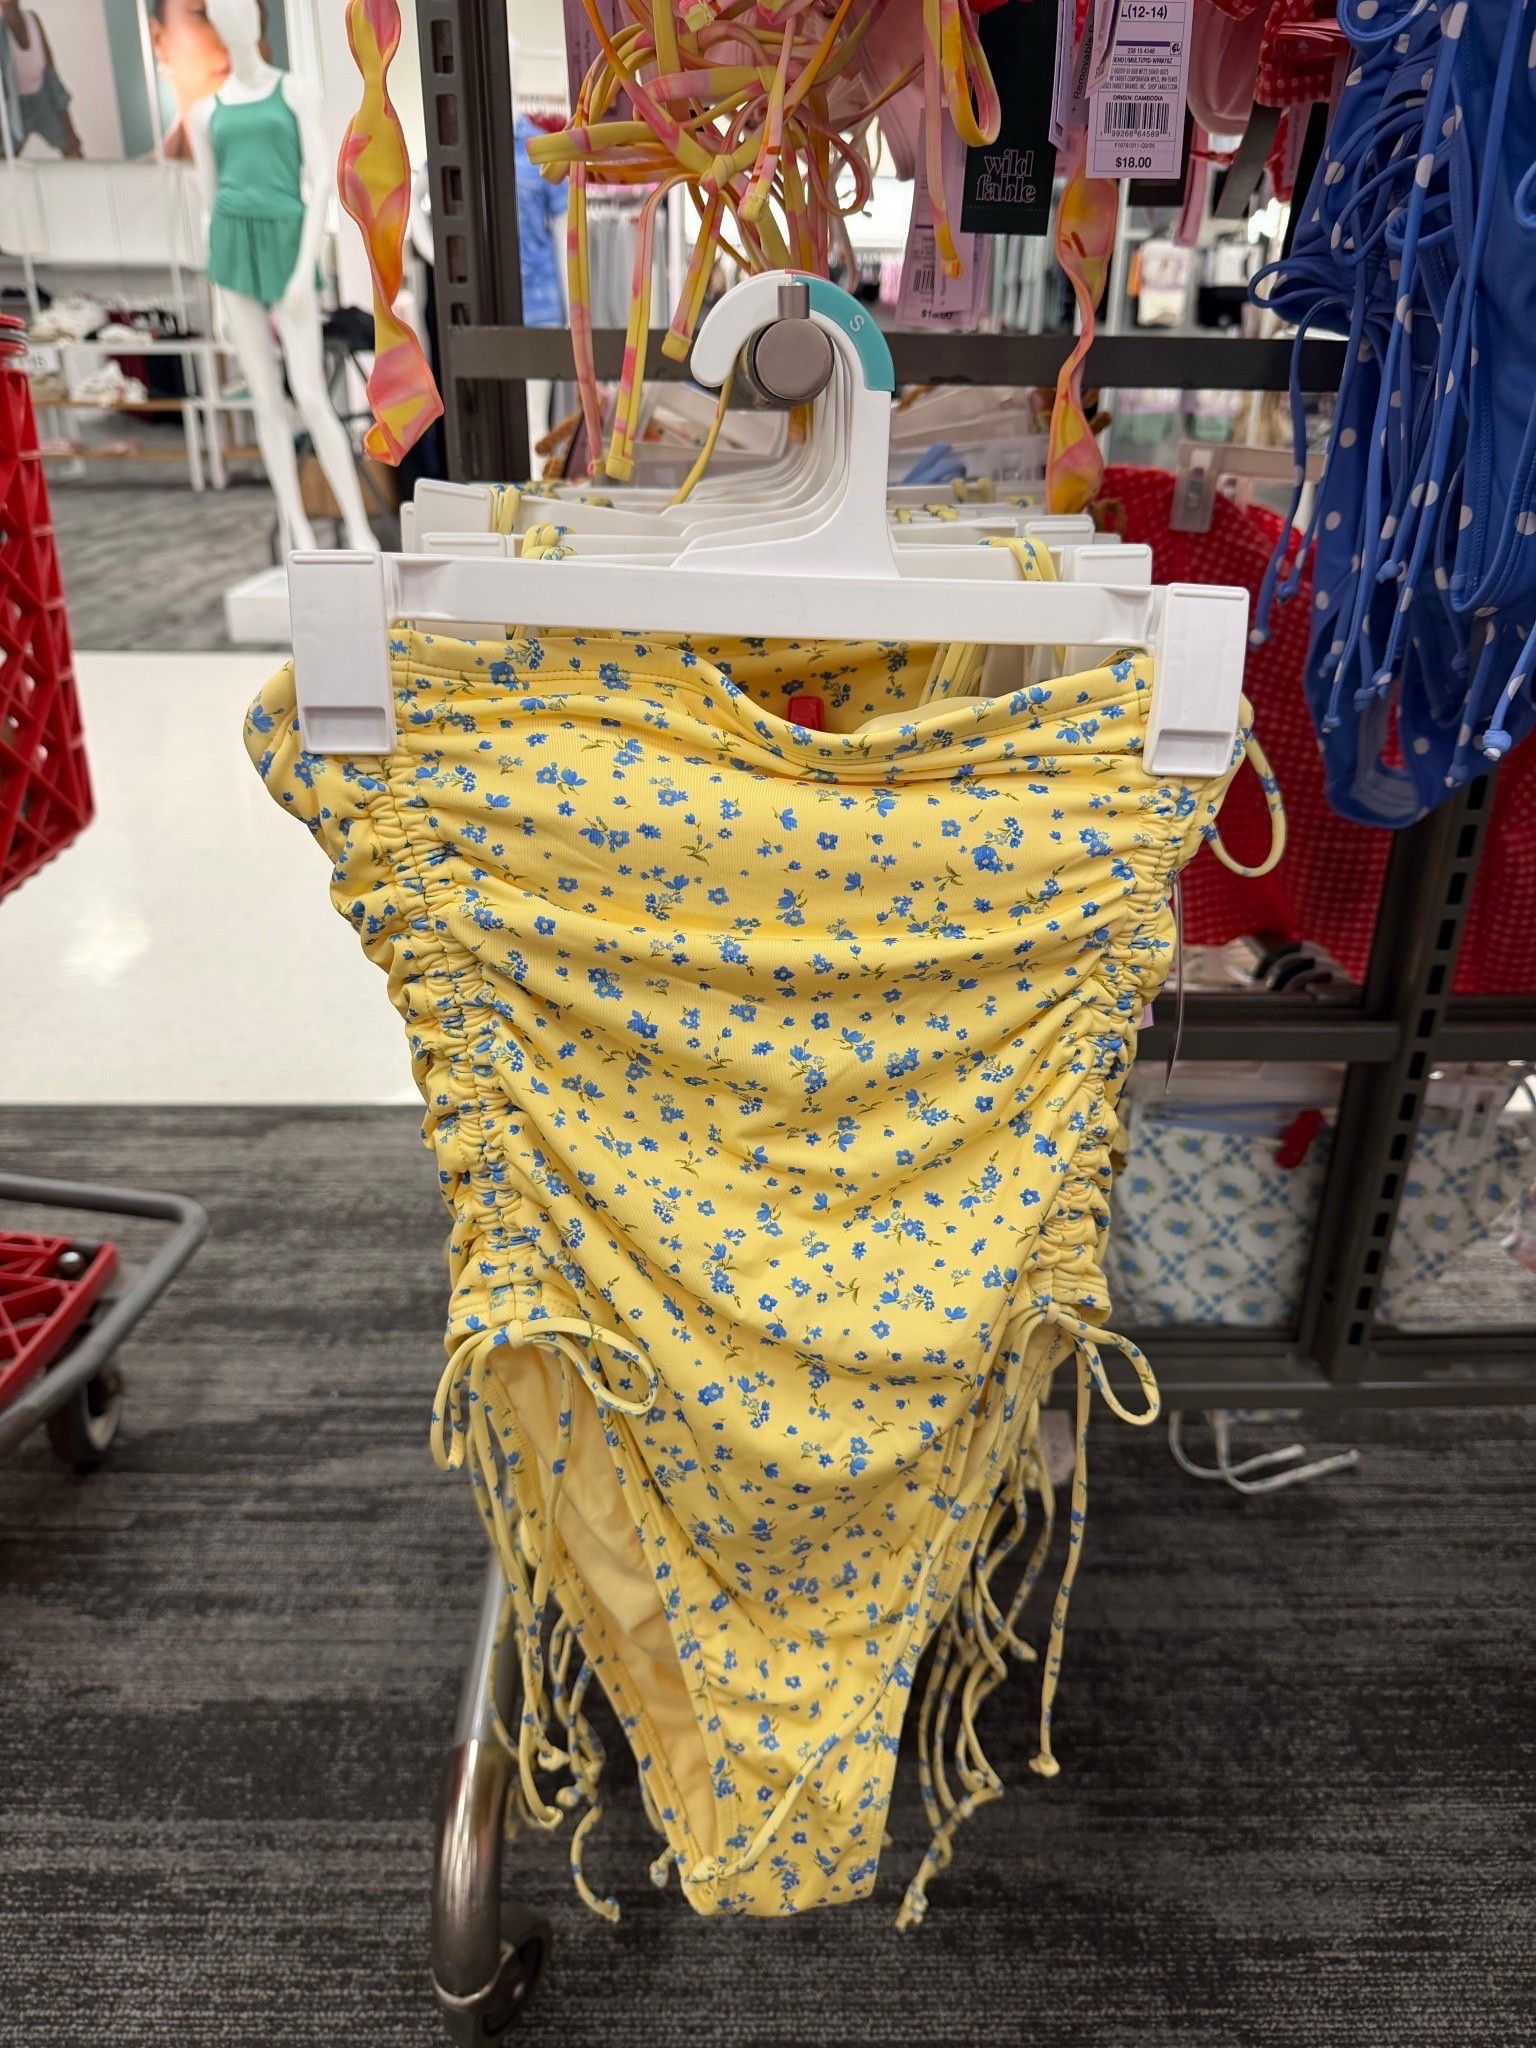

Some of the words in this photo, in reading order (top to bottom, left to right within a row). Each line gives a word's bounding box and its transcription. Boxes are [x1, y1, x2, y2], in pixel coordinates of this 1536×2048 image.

[1121, 4, 1168, 19] L(12-14)
[1073, 35, 1093, 99] Removable
[984, 149, 1034, 177] wild
[1115, 156, 1152, 169] $18.00
[976, 174, 1036, 203] fable
[849, 314, 865, 332] S
